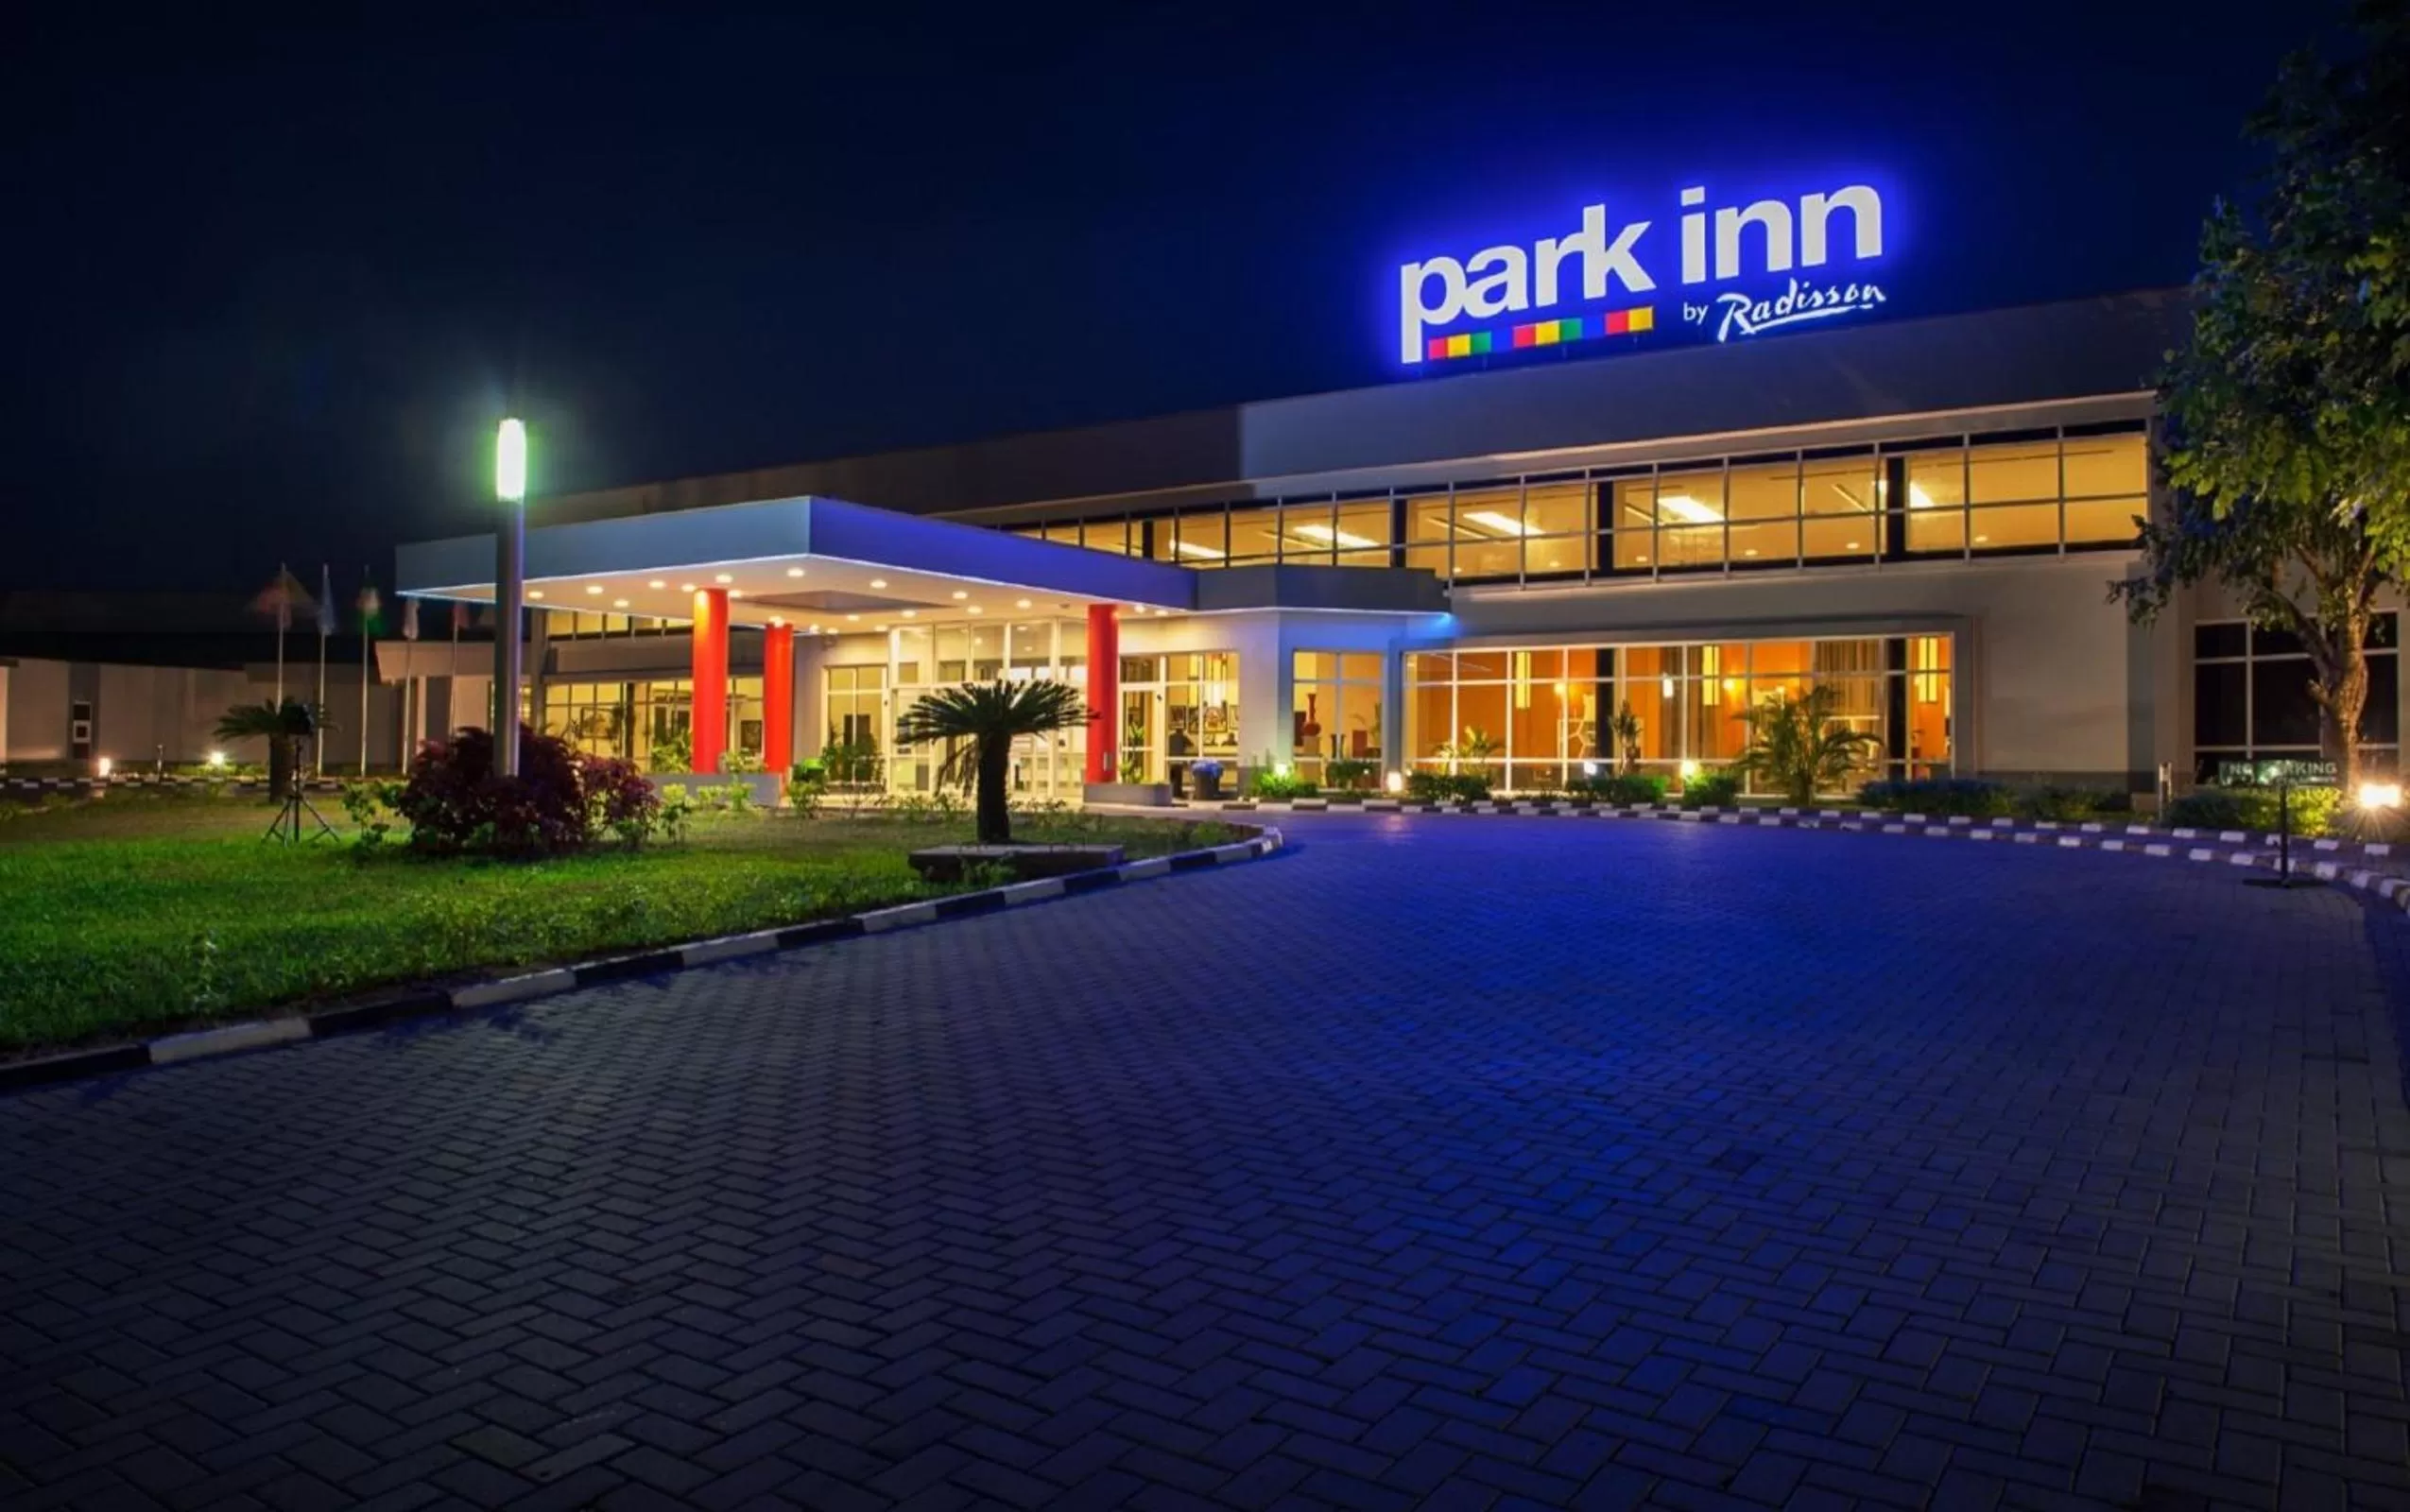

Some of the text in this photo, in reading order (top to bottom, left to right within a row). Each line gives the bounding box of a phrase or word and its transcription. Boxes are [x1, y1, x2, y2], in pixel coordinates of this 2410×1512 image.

[1401, 184, 1883, 363] park inn
[1683, 277, 1886, 342] by Radisson
[2263, 761, 2337, 775] RKING
